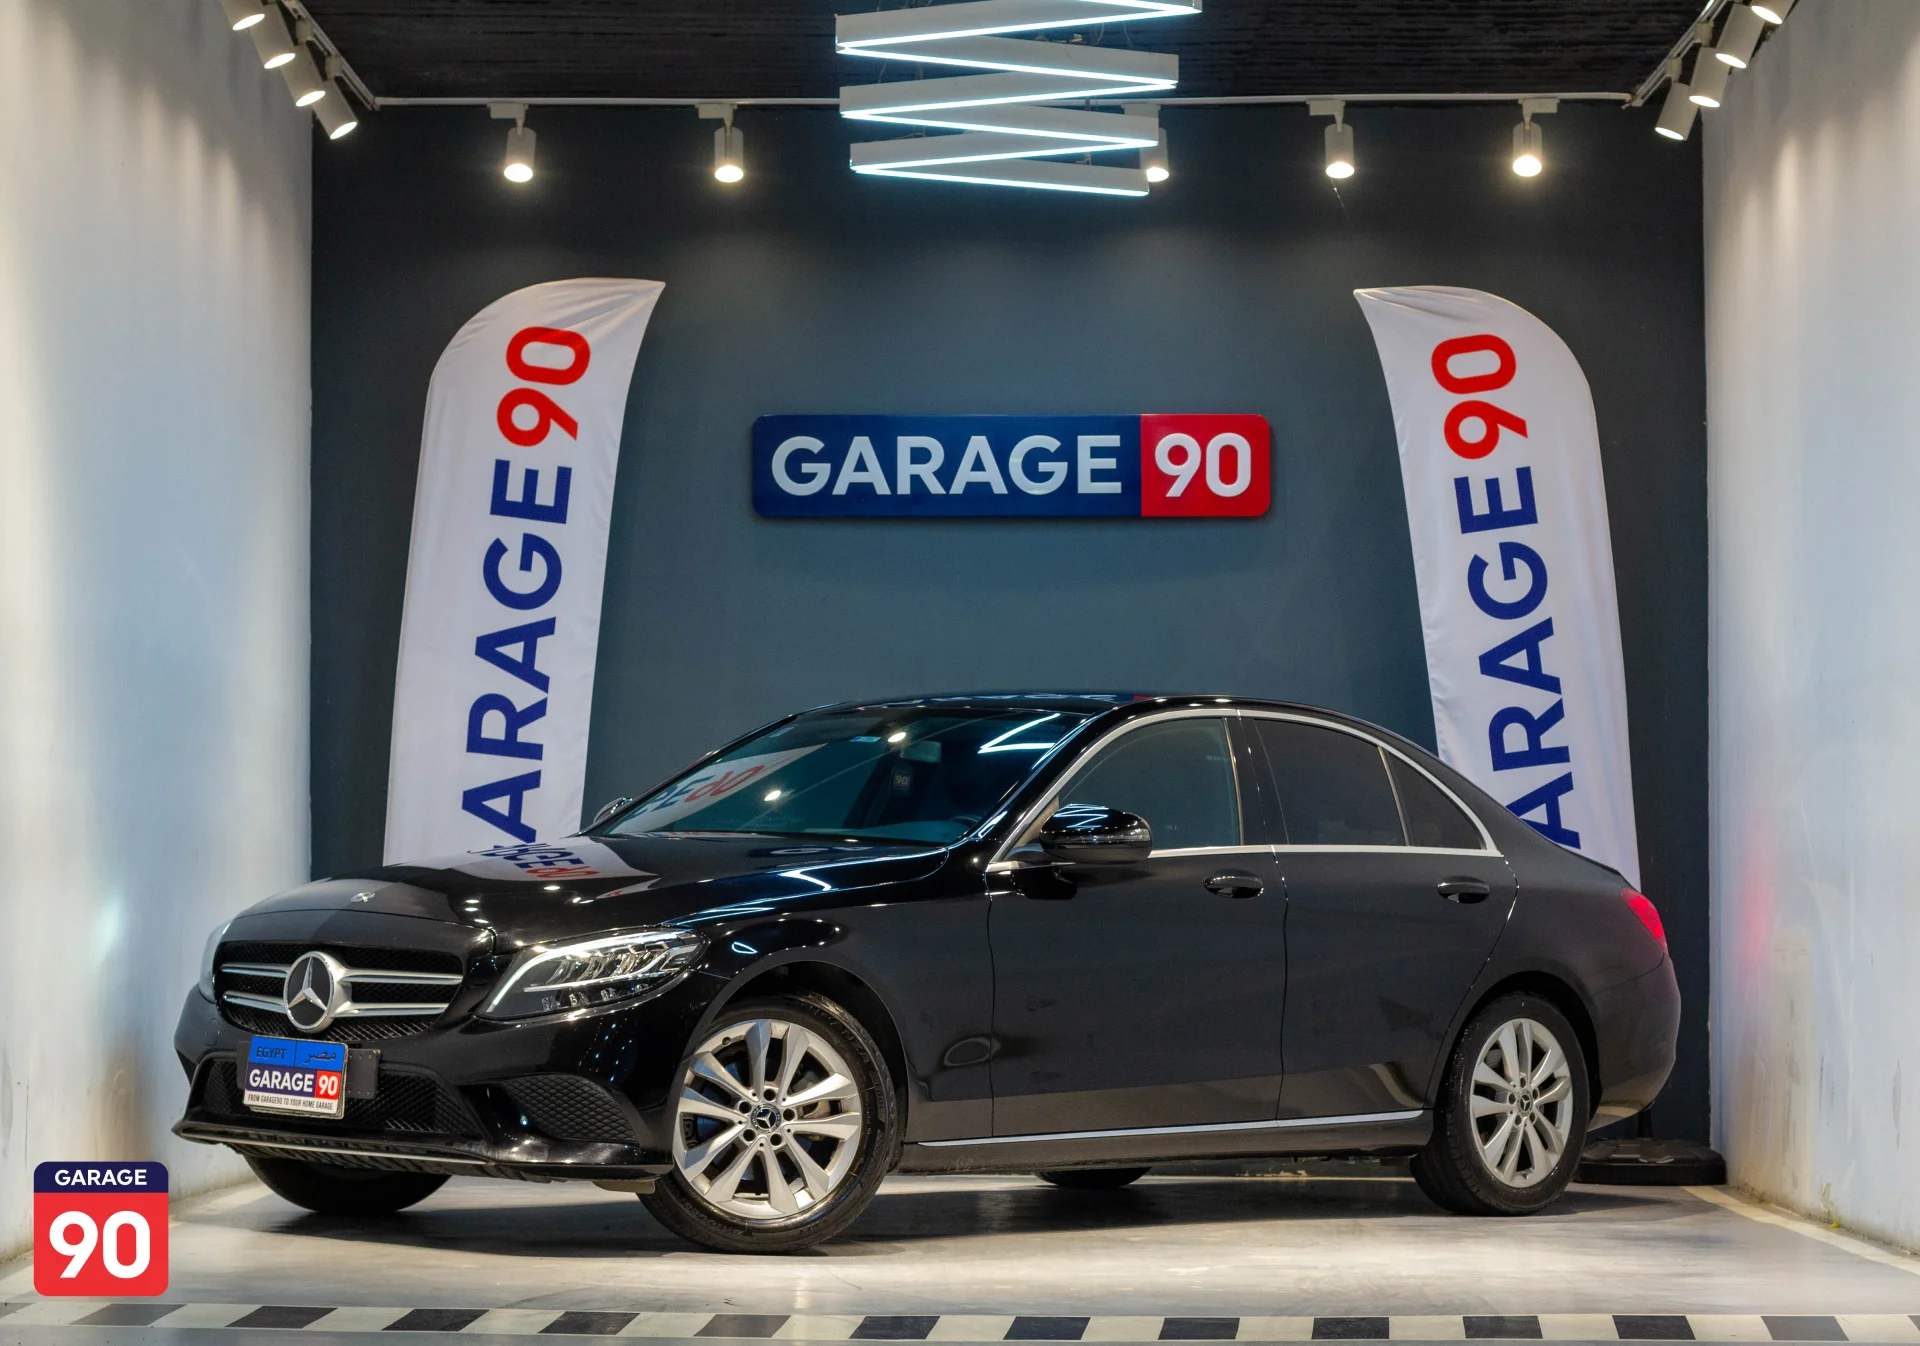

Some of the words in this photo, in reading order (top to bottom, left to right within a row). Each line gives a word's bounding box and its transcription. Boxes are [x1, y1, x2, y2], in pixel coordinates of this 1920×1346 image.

[771, 434, 1122, 496] GARAGE
[1154, 432, 1252, 498] 90
[256, 1046, 288, 1060] EGYPT
[303, 1050, 337, 1064] مصر
[249, 1069, 314, 1093] GARAGE
[318, 1075, 338, 1096] 90
[248, 1094, 260, 1103] FROM
[290, 1098, 302, 1107] YOUR
[302, 1100, 315, 1108] HOME
[316, 1101, 333, 1110] GARAGE
